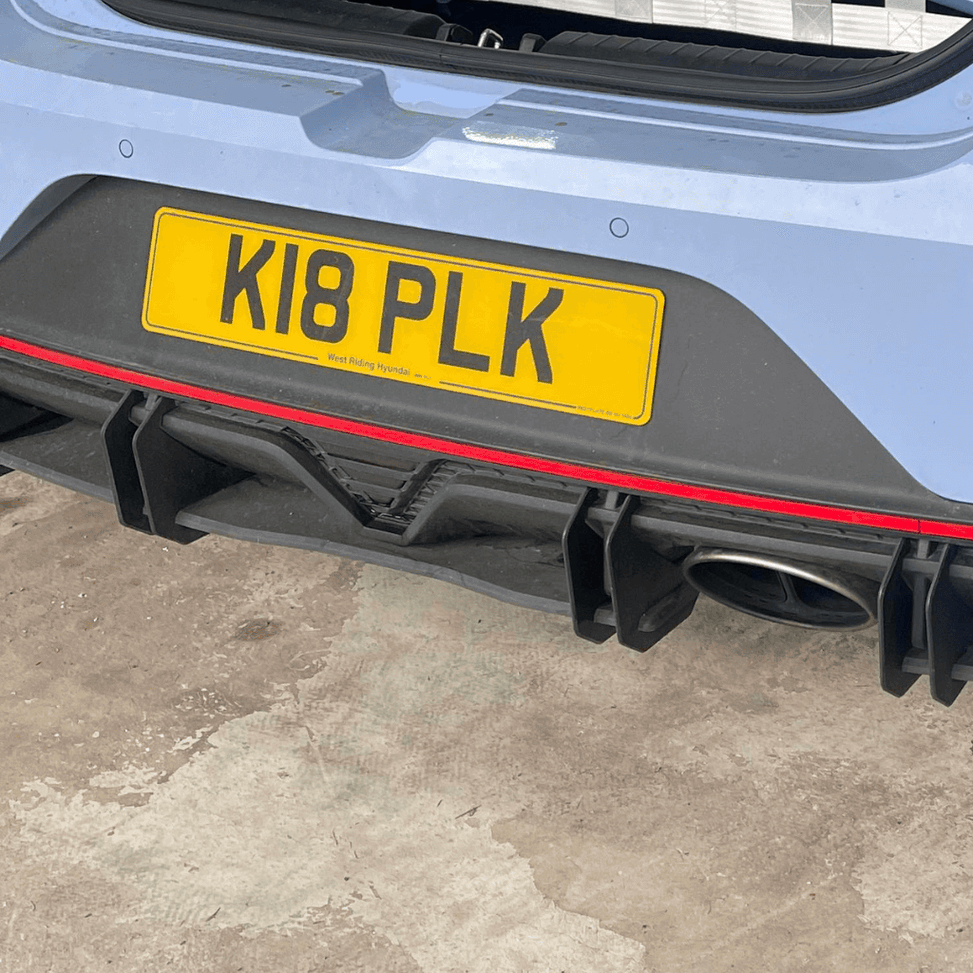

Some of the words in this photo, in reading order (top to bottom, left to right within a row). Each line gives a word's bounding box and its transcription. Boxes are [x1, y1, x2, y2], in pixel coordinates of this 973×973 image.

[220, 233, 355, 344] K18
[377, 260, 564, 384] PLK
[327, 352, 347, 364] West
[348, 356, 375, 371] Riding
[376, 362, 411, 376] Hyundai
